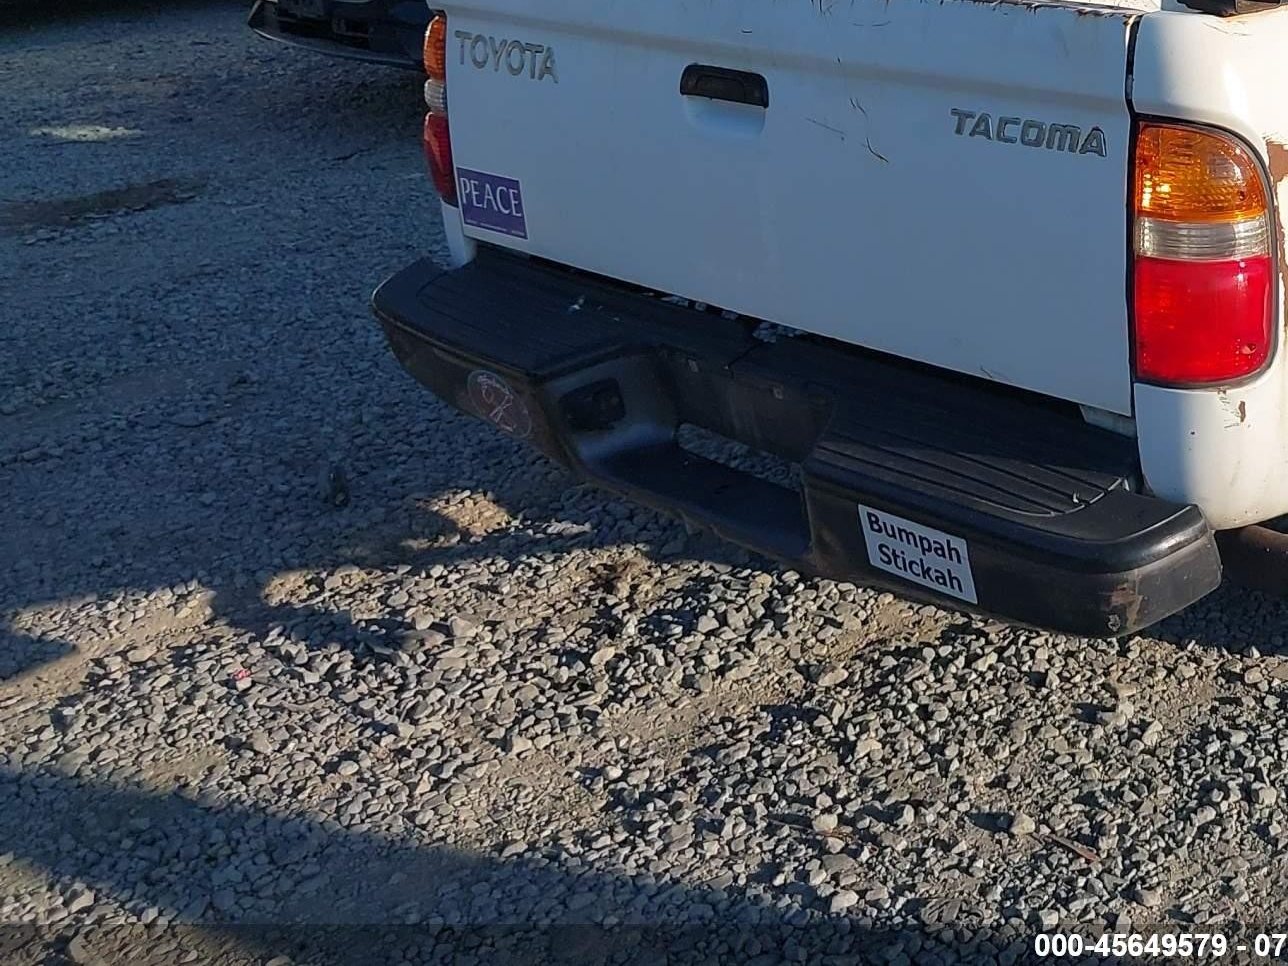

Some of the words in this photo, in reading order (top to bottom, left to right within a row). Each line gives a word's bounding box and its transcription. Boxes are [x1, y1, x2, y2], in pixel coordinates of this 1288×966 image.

[454, 30, 559, 84] TOYOTA
[950, 108, 1108, 158] TACOMA
[460, 177, 522, 217] PEACE
[866, 512, 962, 565] Bumpah
[878, 543, 963, 593] Stickah
